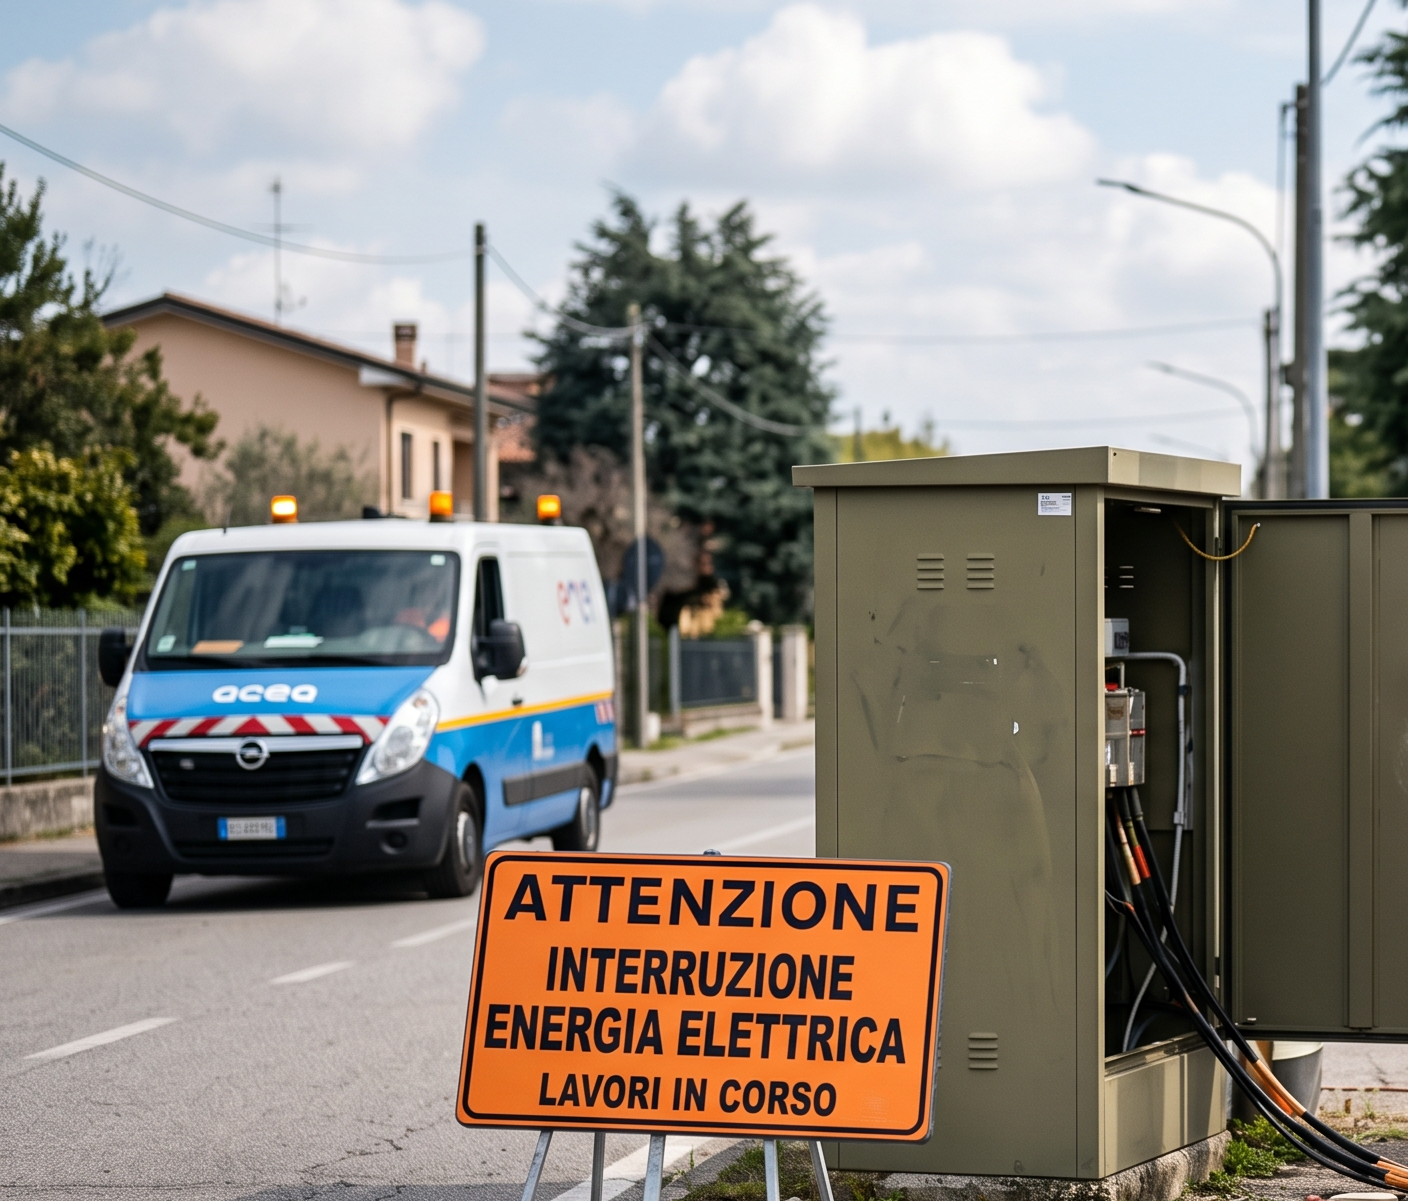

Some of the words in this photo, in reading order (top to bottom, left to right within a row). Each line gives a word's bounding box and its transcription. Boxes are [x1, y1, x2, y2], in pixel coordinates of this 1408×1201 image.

[211, 683, 319, 704] acea
[503, 873, 921, 933] ATTENZIONE
[546, 946, 855, 1001] INTERRUZIONE
[483, 1003, 664, 1055] ENERGIA
[677, 1010, 906, 1064] ELETTRICA
[538, 1072, 662, 1110] LAVORI
[672, 1077, 708, 1112] IN
[719, 1079, 837, 1117] CORSO
